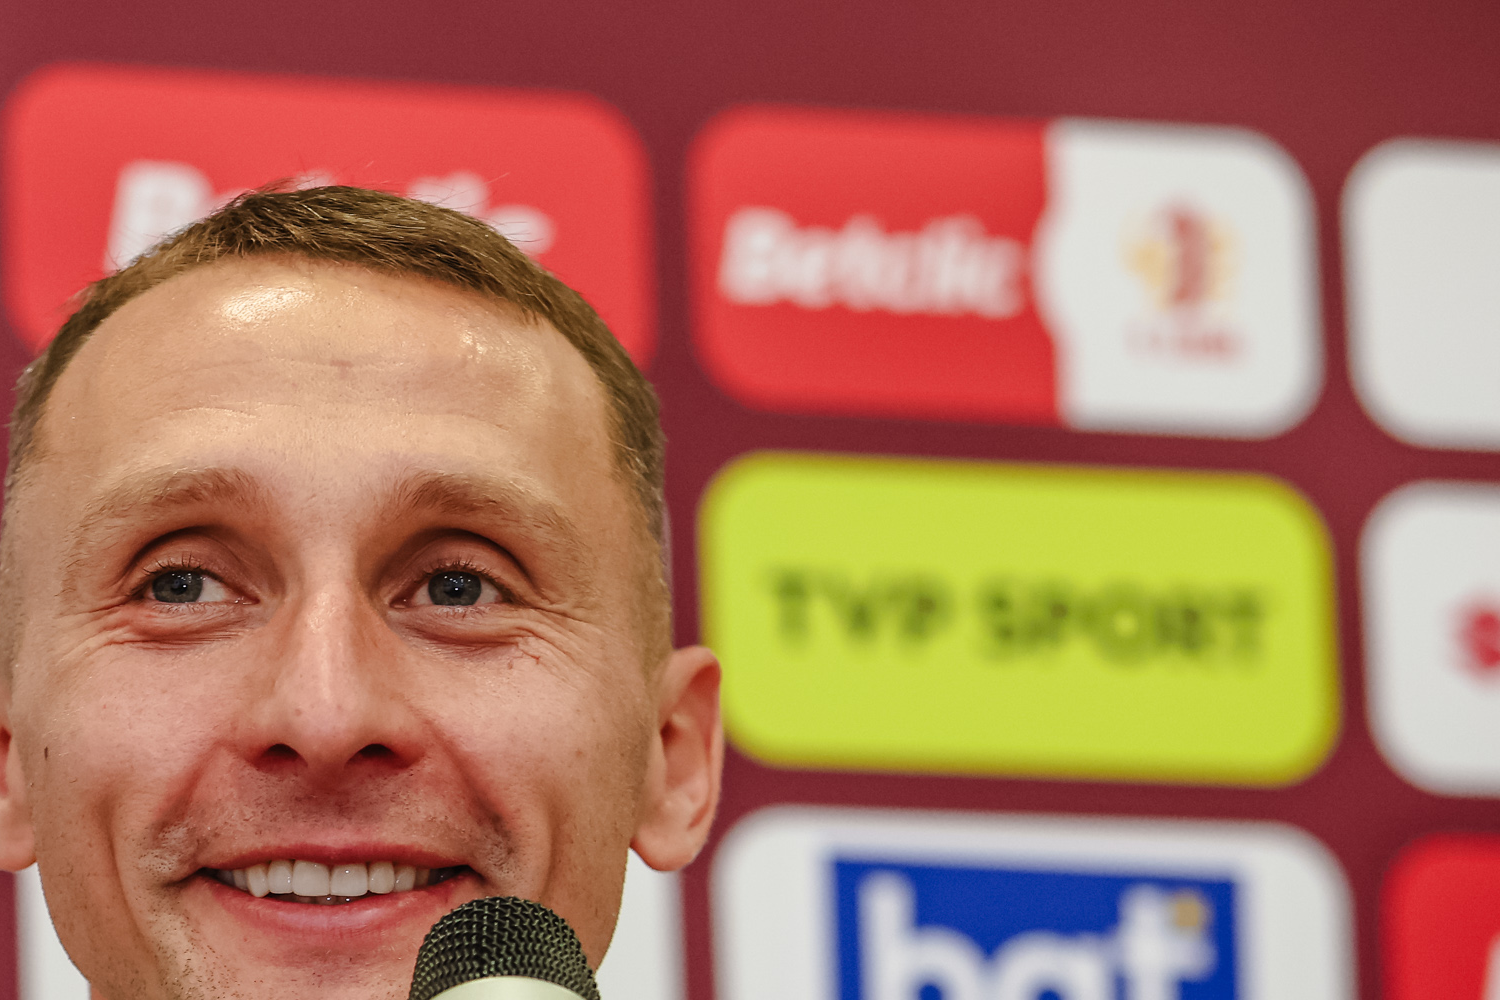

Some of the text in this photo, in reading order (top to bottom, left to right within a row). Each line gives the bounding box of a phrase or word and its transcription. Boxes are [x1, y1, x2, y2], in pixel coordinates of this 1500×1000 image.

[718, 206, 1032, 320] Betclic
[766, 565, 1272, 672] TVP SPORT
